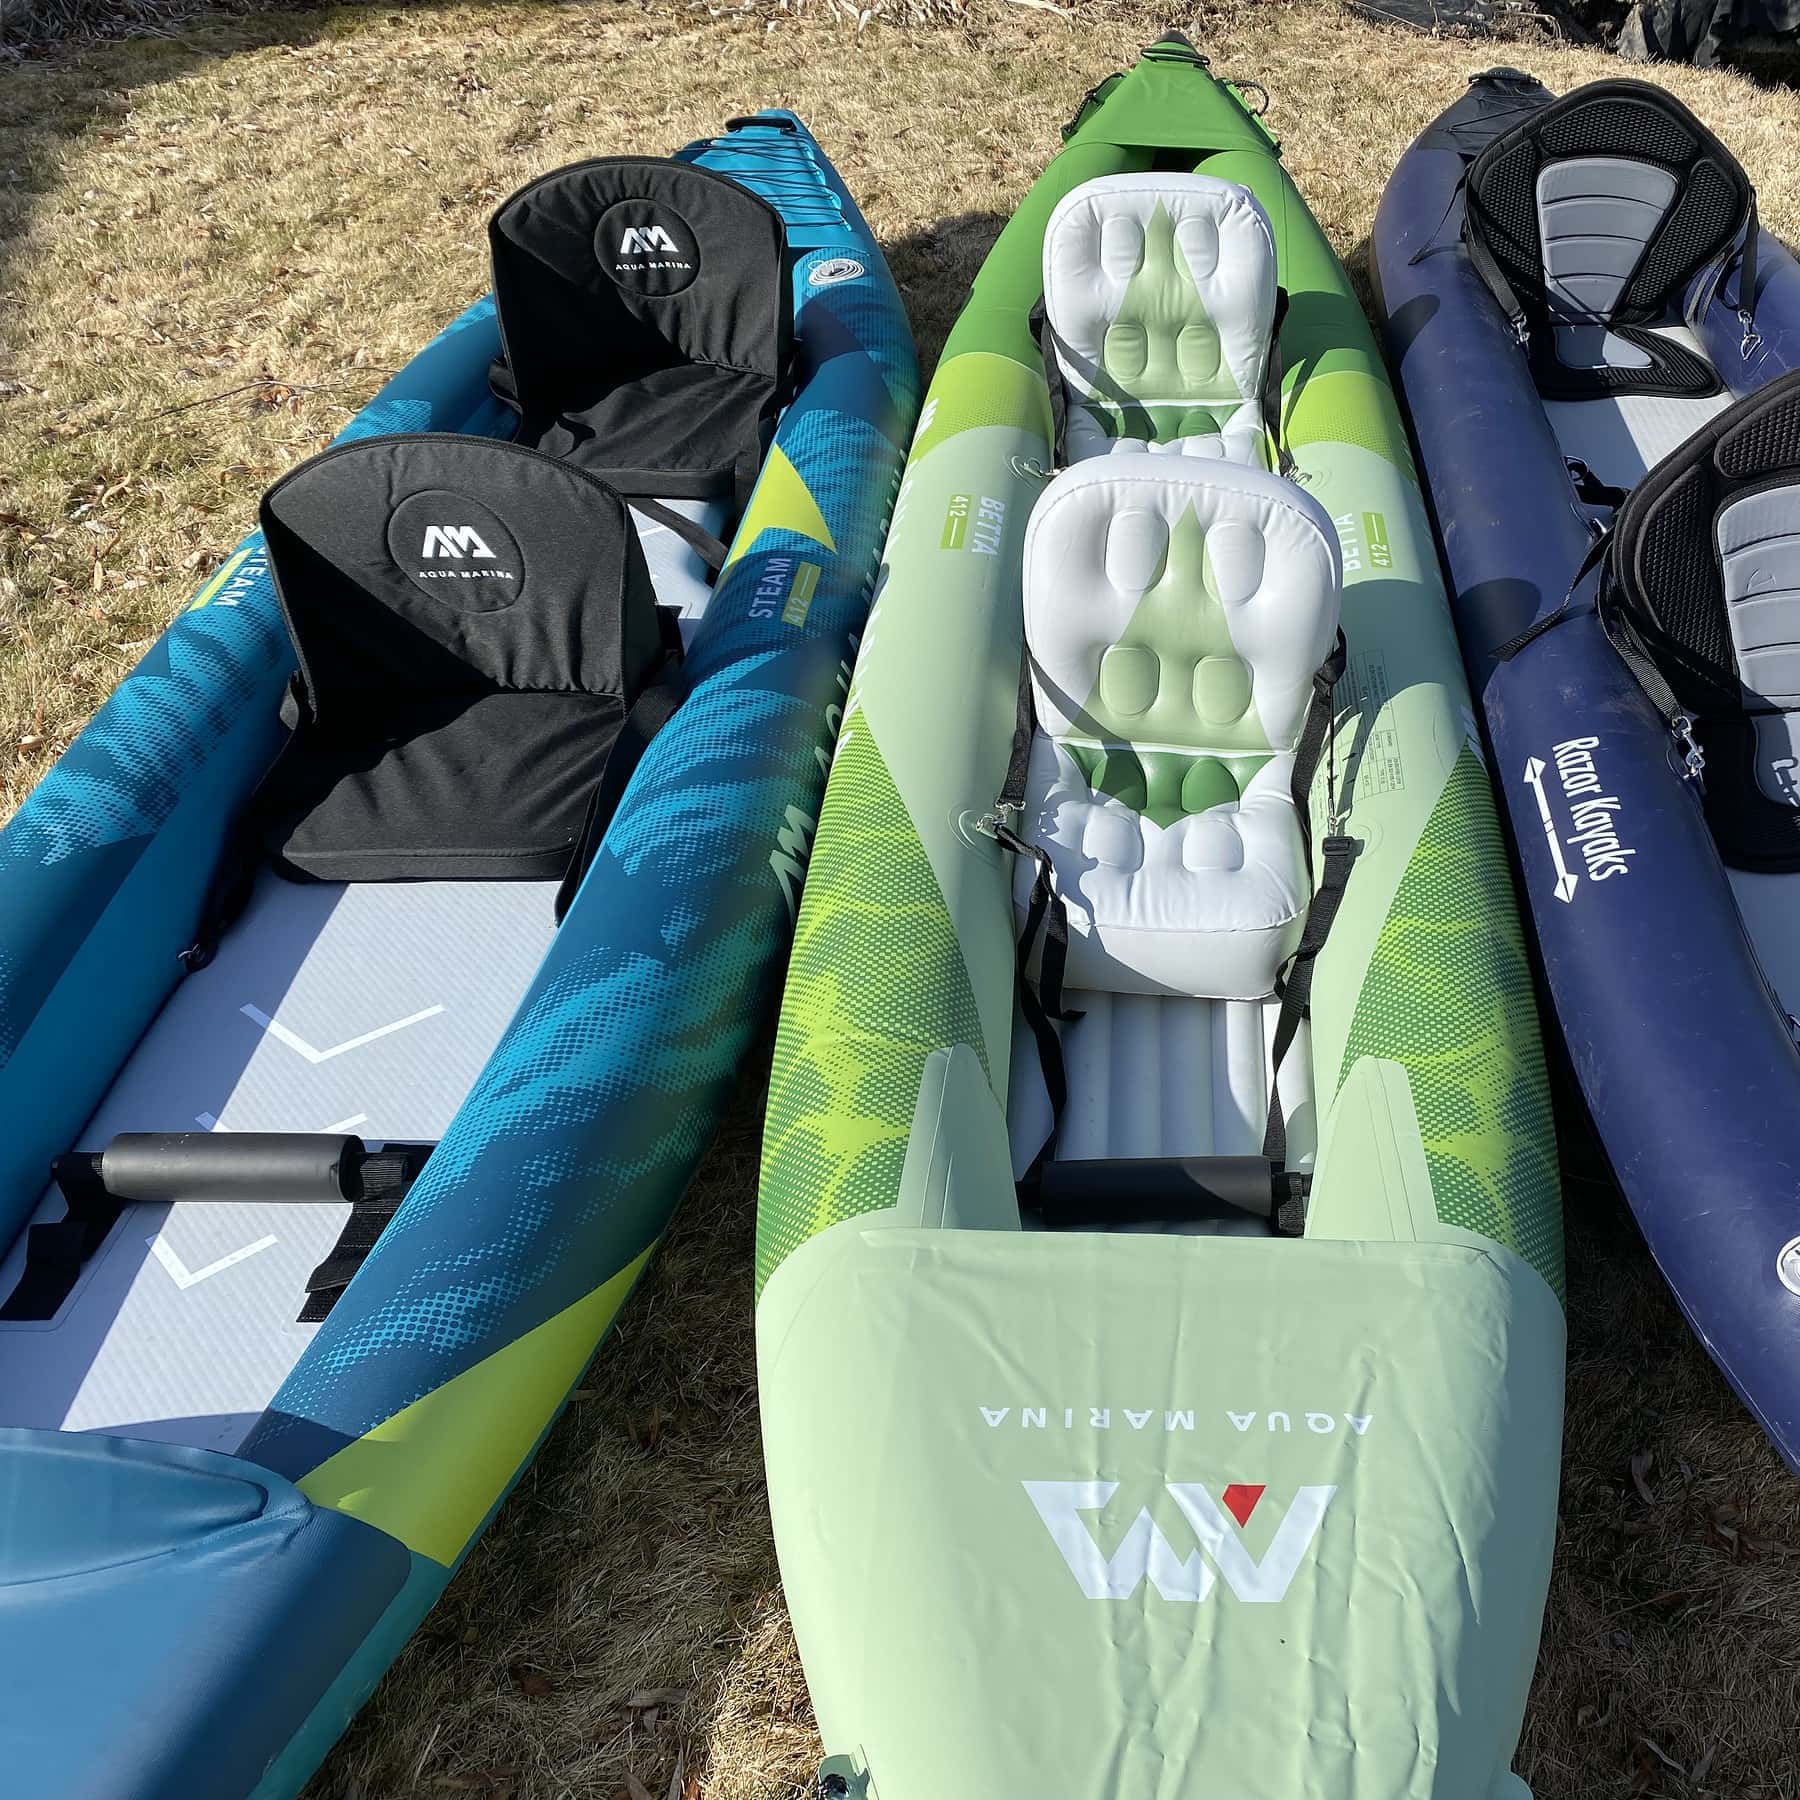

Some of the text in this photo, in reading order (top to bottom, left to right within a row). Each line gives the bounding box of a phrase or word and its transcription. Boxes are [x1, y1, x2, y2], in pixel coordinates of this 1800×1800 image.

[615, 261, 692, 271] AQUA MARINA
[971, 495, 1006, 556] BETTA
[418, 569, 514, 580] AQUA MARINA
[747, 557, 793, 619] STEAM
[1551, 735, 1637, 882] Razor Kayaks
[979, 1406, 1374, 1436] AQUA MARINA
